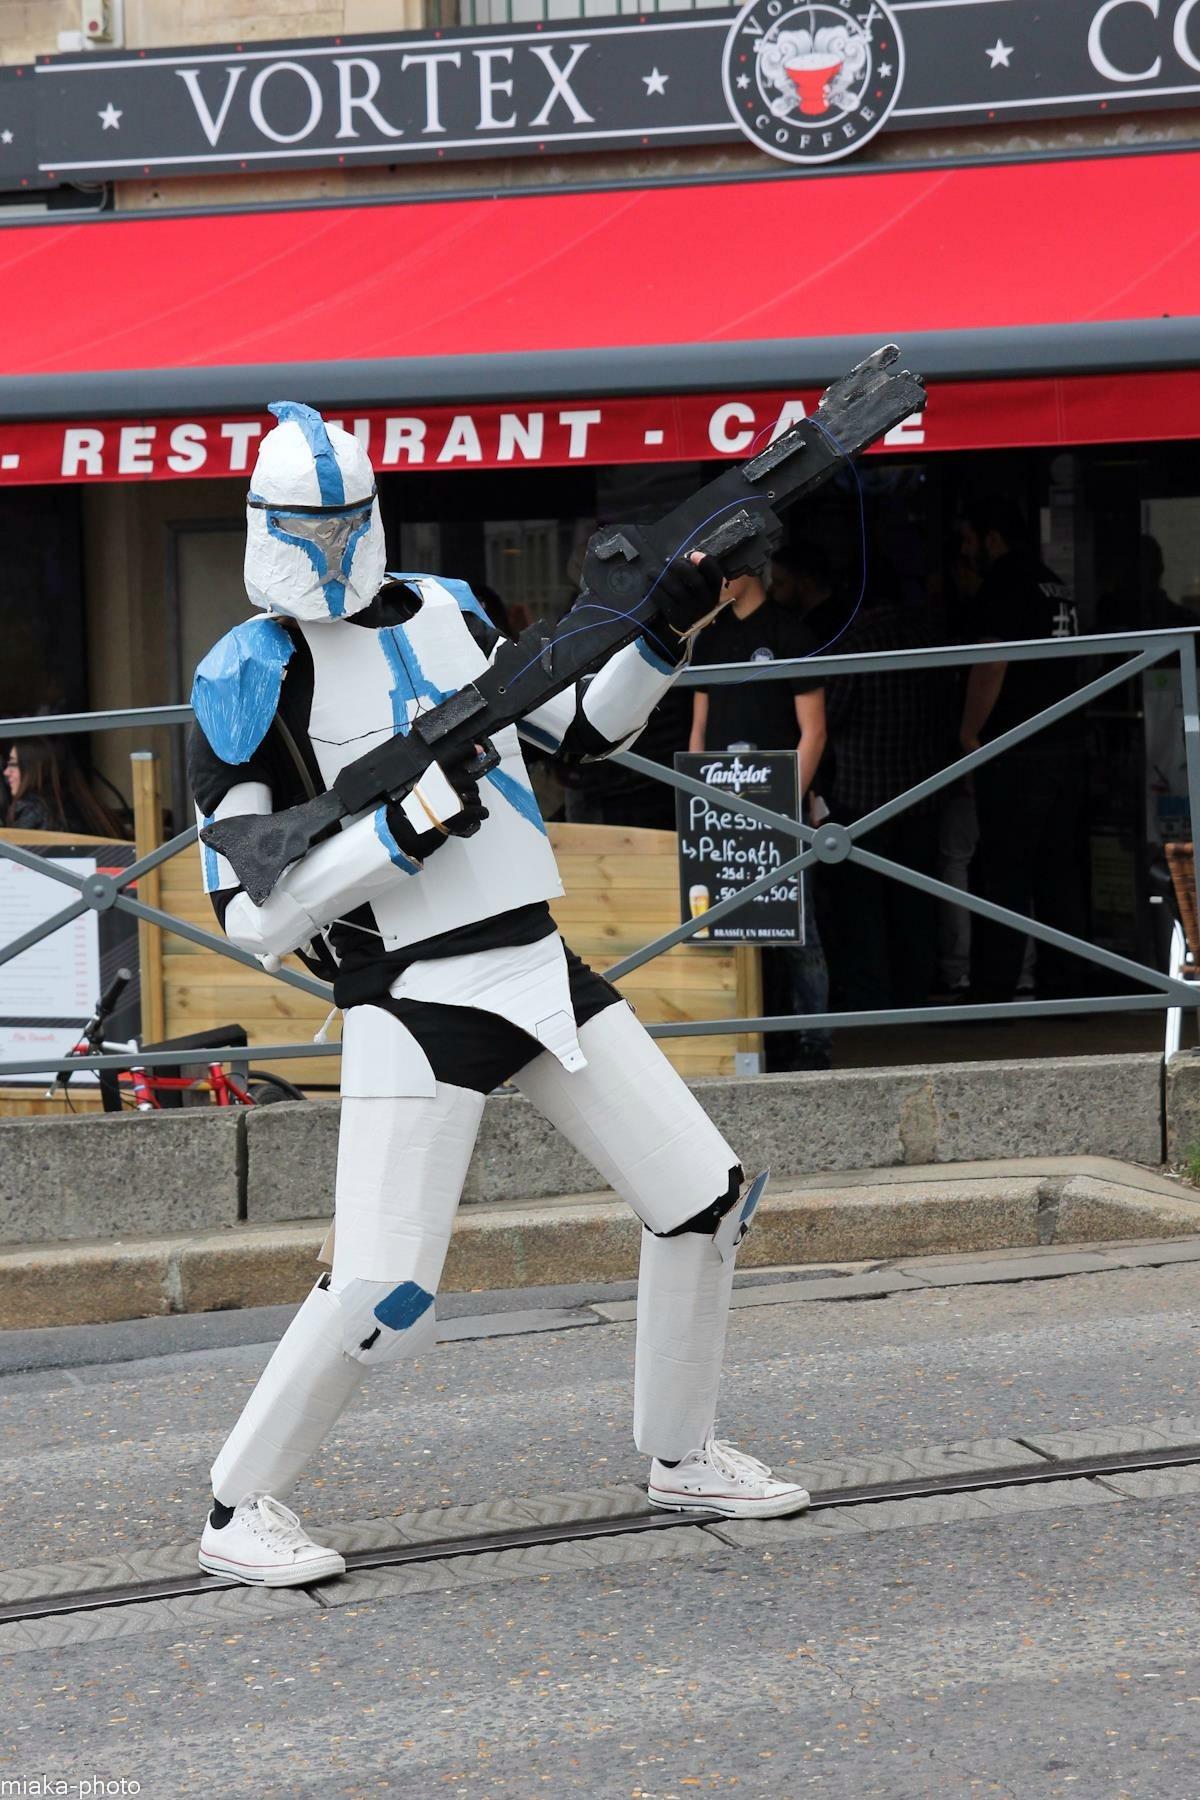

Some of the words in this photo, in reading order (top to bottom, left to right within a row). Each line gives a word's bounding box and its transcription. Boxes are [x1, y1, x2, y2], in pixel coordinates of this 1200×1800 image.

[741, 0, 884, 35] VOEX
[175, 43, 595, 147] VORTEX
[755, 105, 876, 149] COFFEE
[61, 410, 601, 476] RESTRANT
[708, 401, 926, 453] CAE
